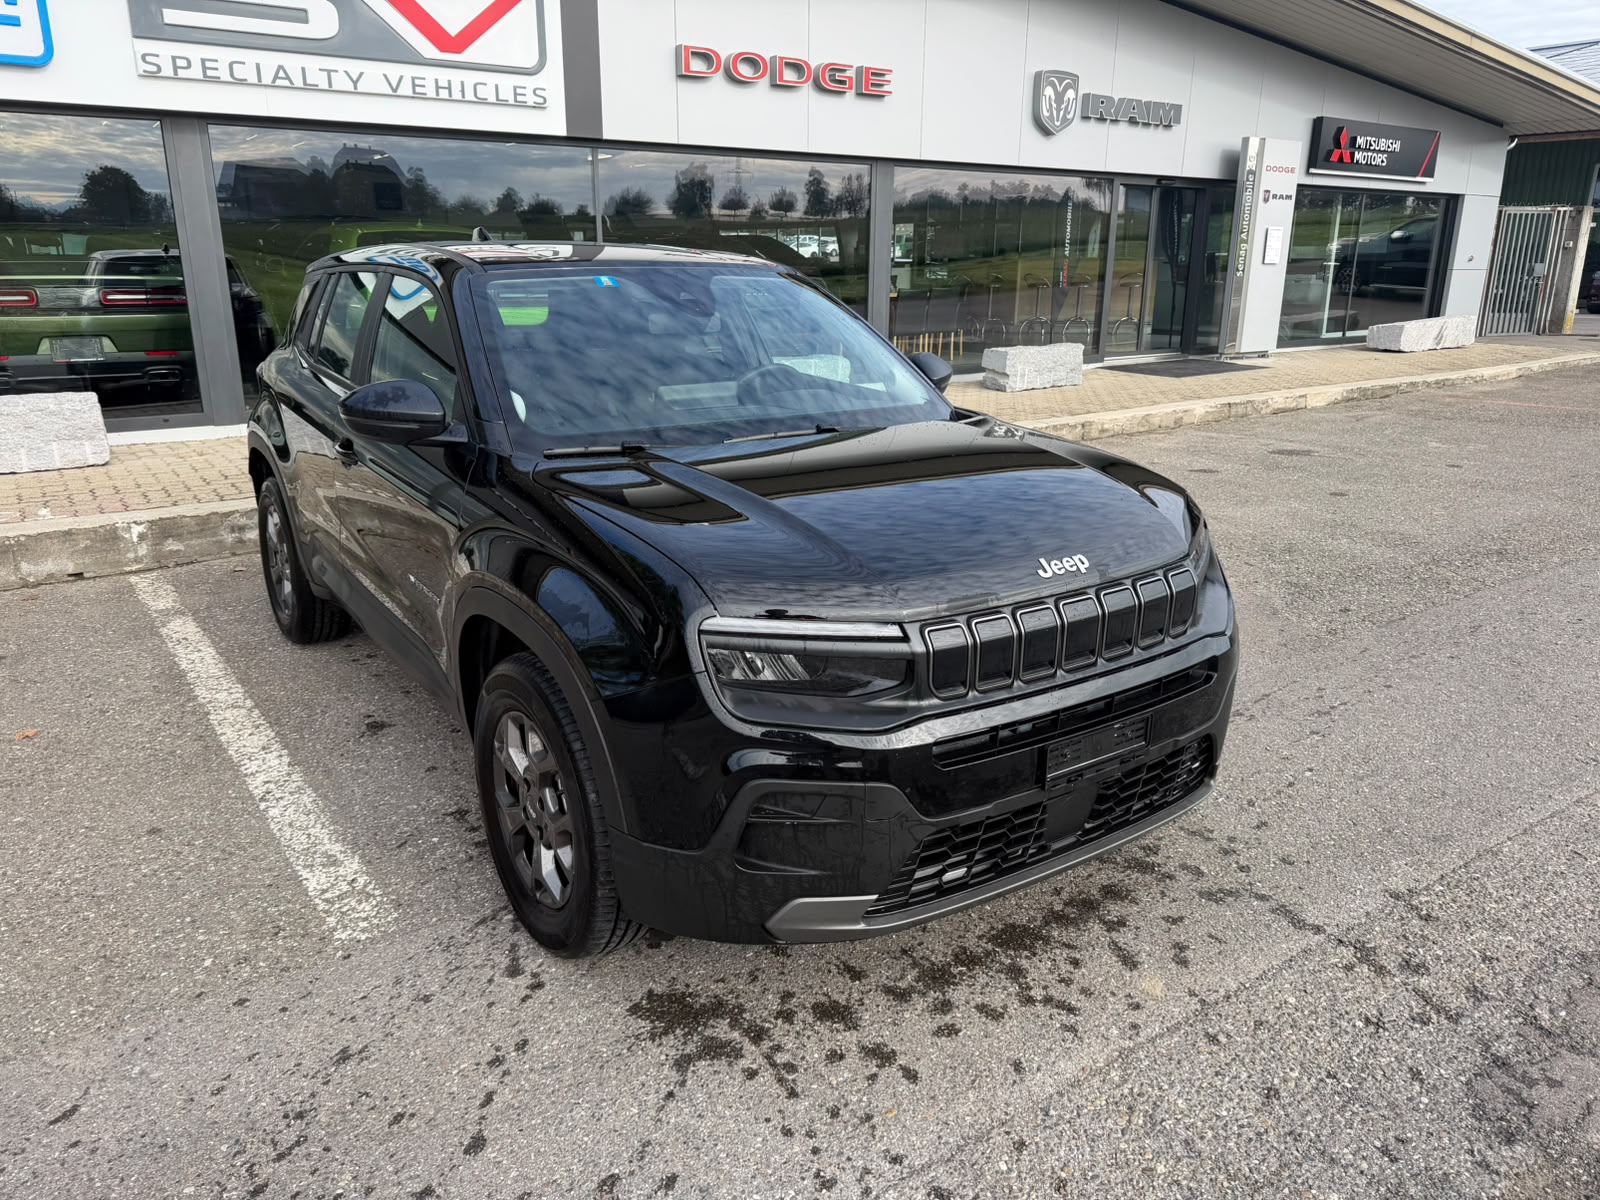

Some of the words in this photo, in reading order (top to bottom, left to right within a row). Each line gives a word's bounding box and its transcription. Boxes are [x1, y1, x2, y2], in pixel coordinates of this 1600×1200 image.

[140, 52, 366, 91] SPECIALTY
[382, 73, 548, 106] VEHICLES
[676, 44, 893, 96] DODGE
[1081, 92, 1183, 126] RAM
[1356, 135, 1401, 152] MITSUBISHI
[1265, 165, 1296, 174] DODGE
[1353, 151, 1388, 166] MOTORS
[1240, 173, 1254, 240] Automobile
[1271, 193, 1293, 201] RAM
[1036, 554, 1089, 578] Jeep
